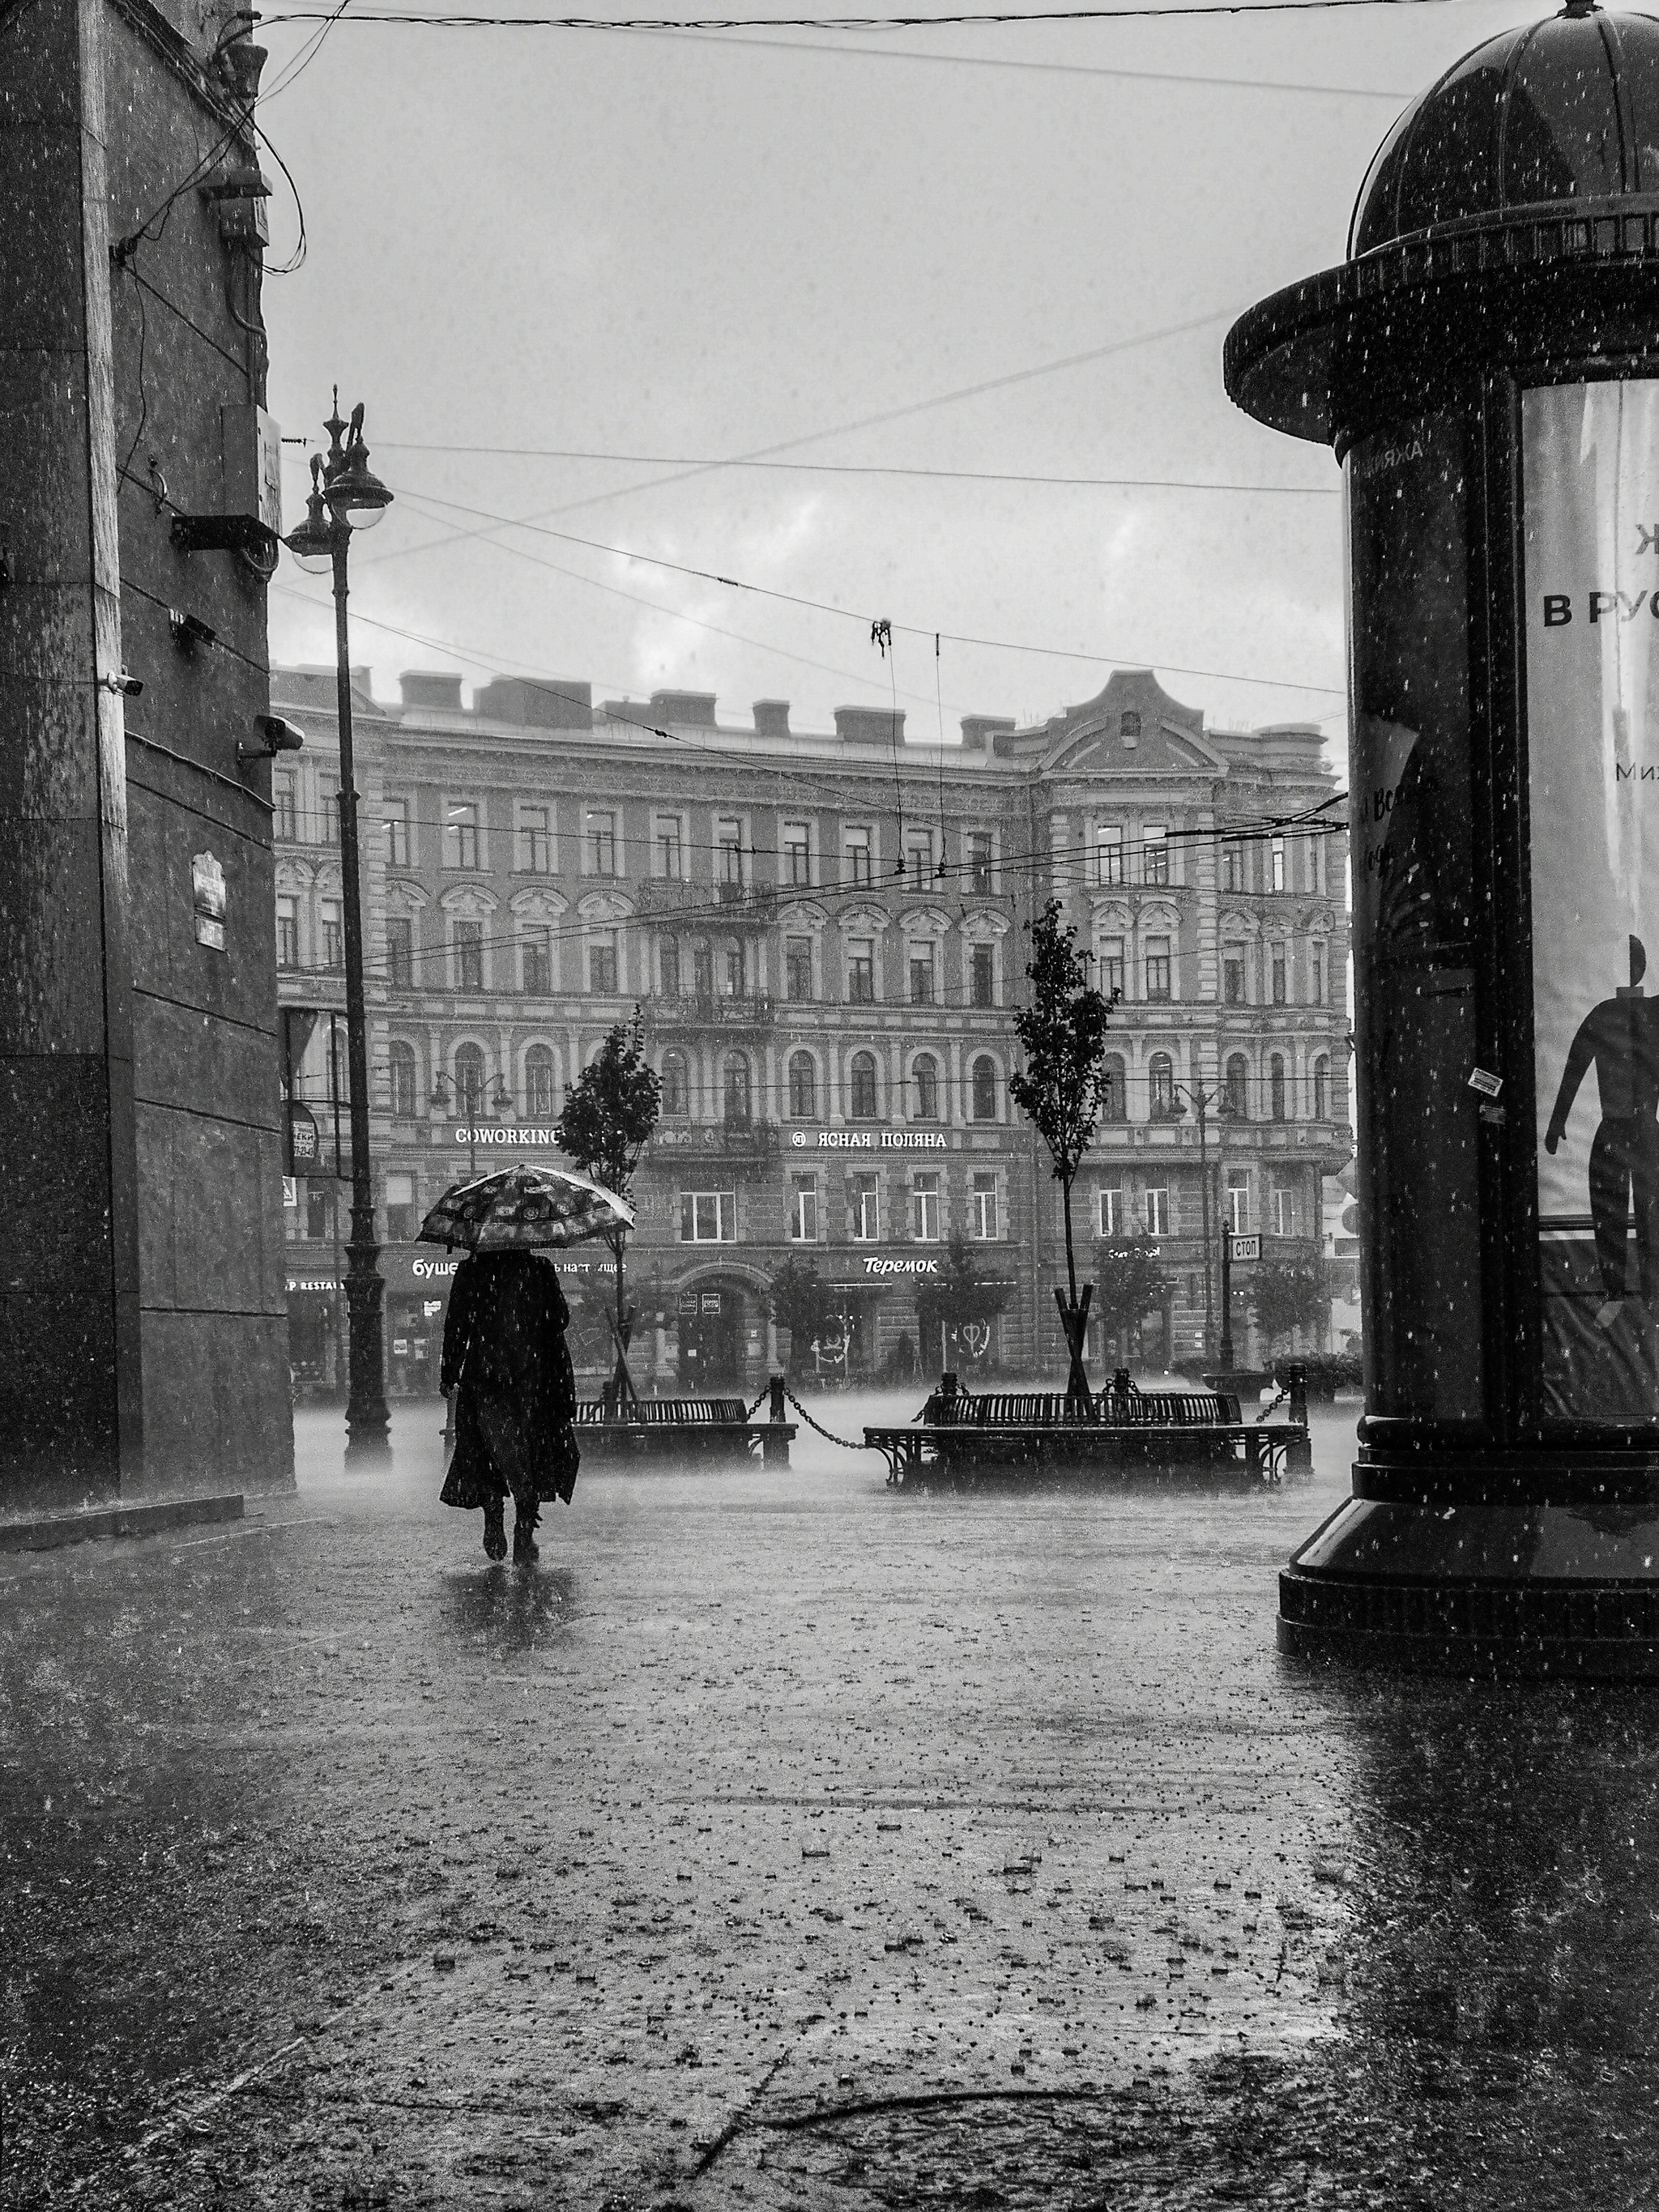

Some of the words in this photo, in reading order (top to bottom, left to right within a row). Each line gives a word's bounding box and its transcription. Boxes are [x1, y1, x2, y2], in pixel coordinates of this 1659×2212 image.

[1543, 594, 1573, 627] В
[818, 1132, 871, 1147] ЯСНАЯ
[881, 1133, 947, 1147] ПОЛЯНА
[1235, 1240, 1256, 1256] СТОП
[412, 1259, 459, 1279] буше
[863, 1257, 937, 1275] Теремок
